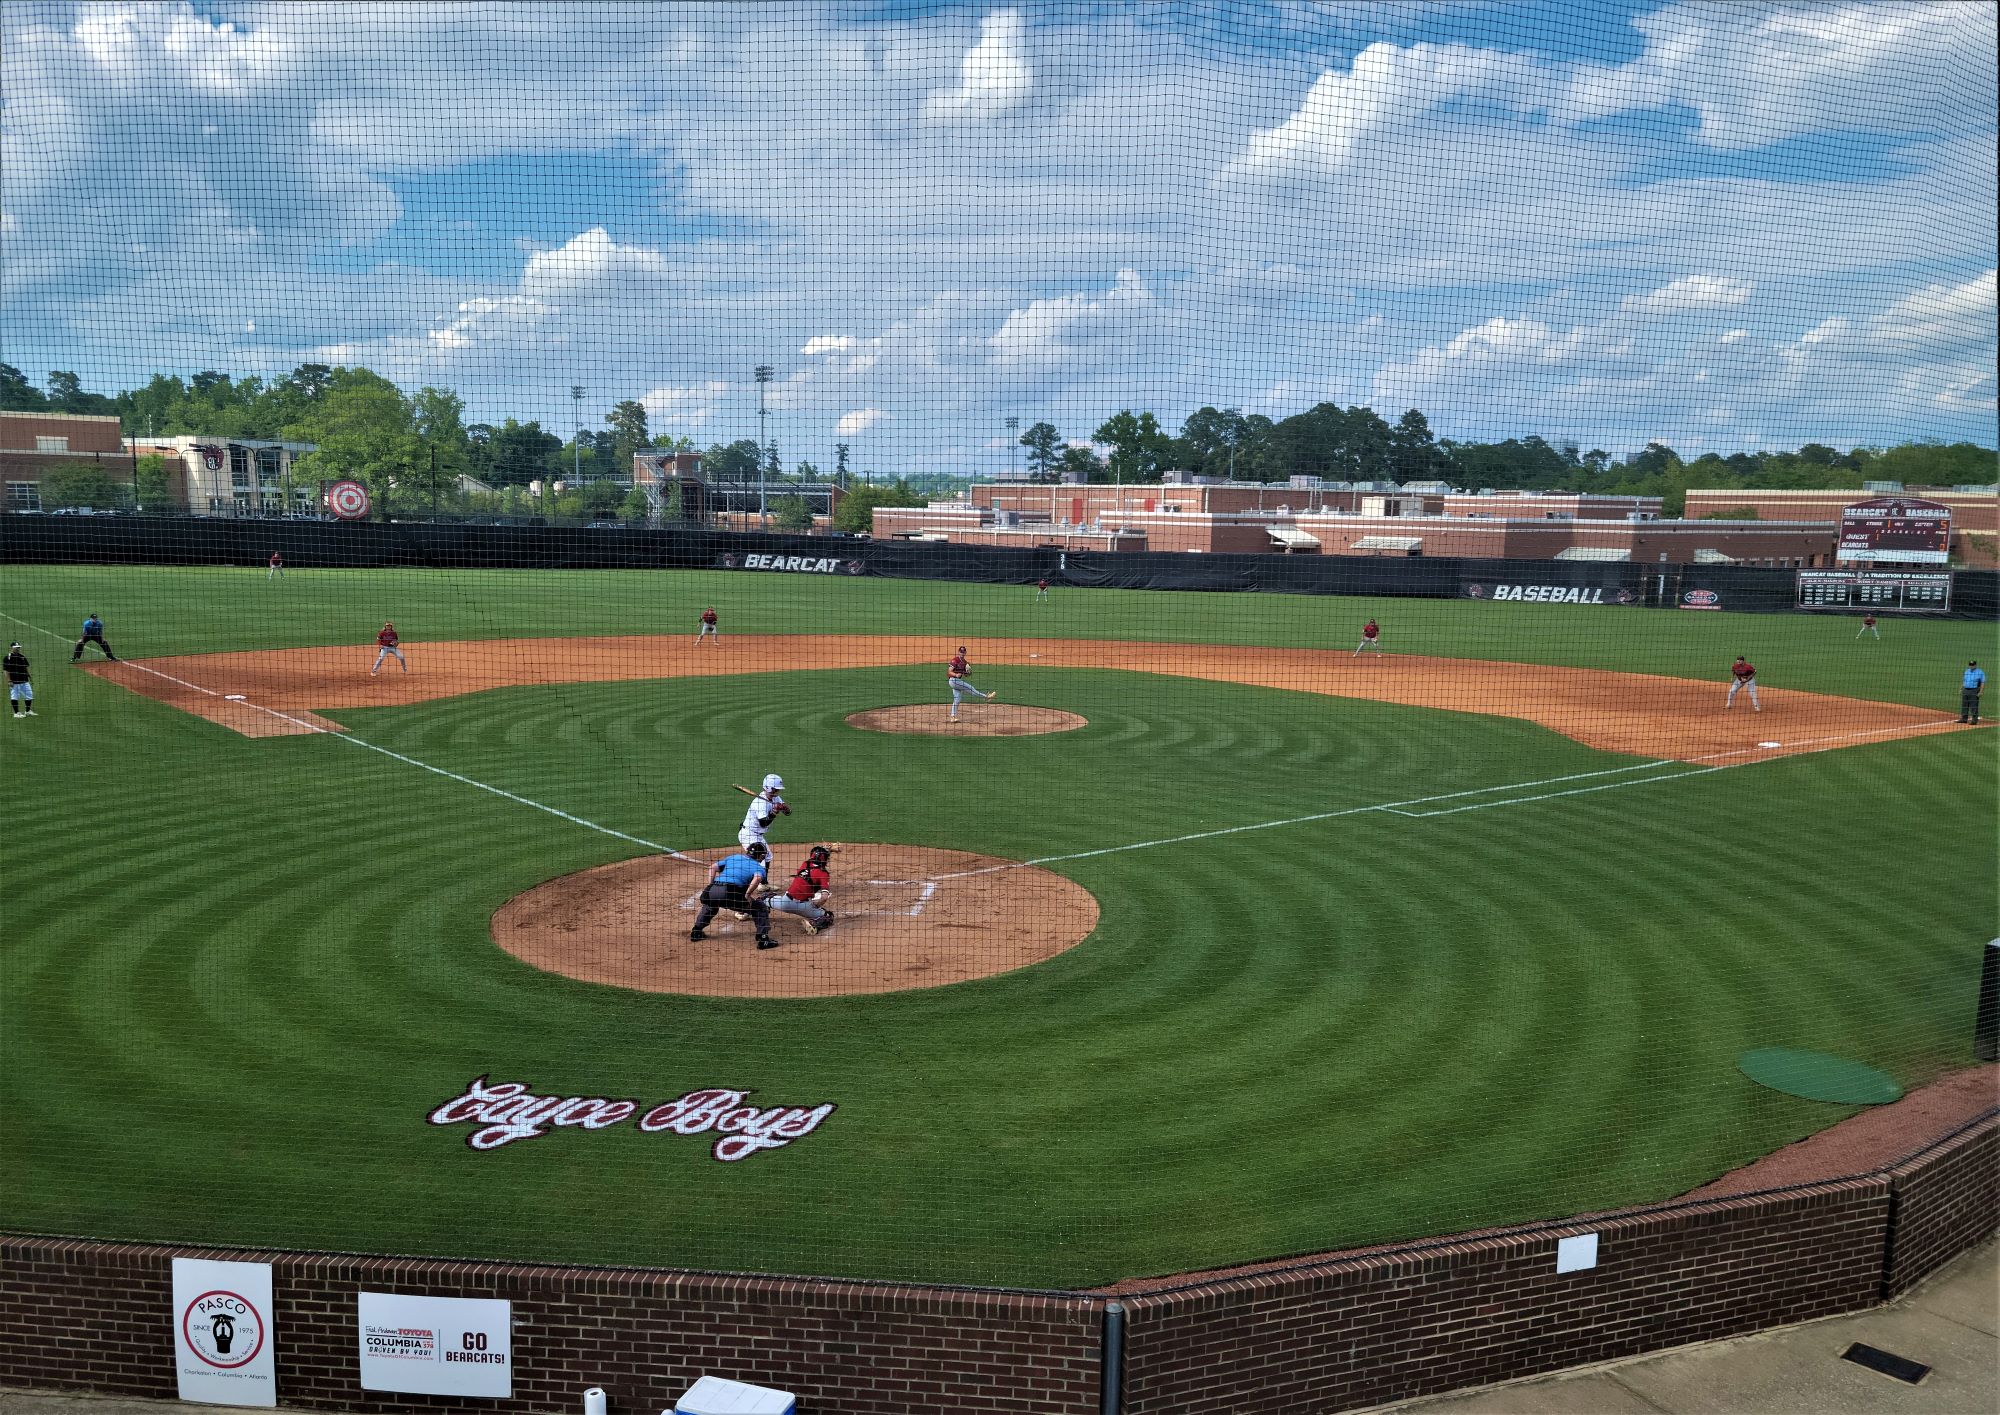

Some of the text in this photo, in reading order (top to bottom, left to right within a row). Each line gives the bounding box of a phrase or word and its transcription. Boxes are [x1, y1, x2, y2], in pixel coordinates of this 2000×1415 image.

[1844, 508, 1950, 517] BEARCAT BASEBALL
[1940, 521, 1947, 529] 5
[744, 554, 840, 572] BEARCAT
[1493, 585, 1604, 604] BASEBALL
[637, 1088, 838, 1162] Boys
[198, 1298, 246, 1314] PASCO
[398, 1328, 433, 1337] TOYOTA
[367, 1338, 421, 1348] COLUMBIA
[463, 1332, 487, 1350] GO
[242, 1342, 254, 1356] Service
[446, 1351, 505, 1364] BEARCATS!
